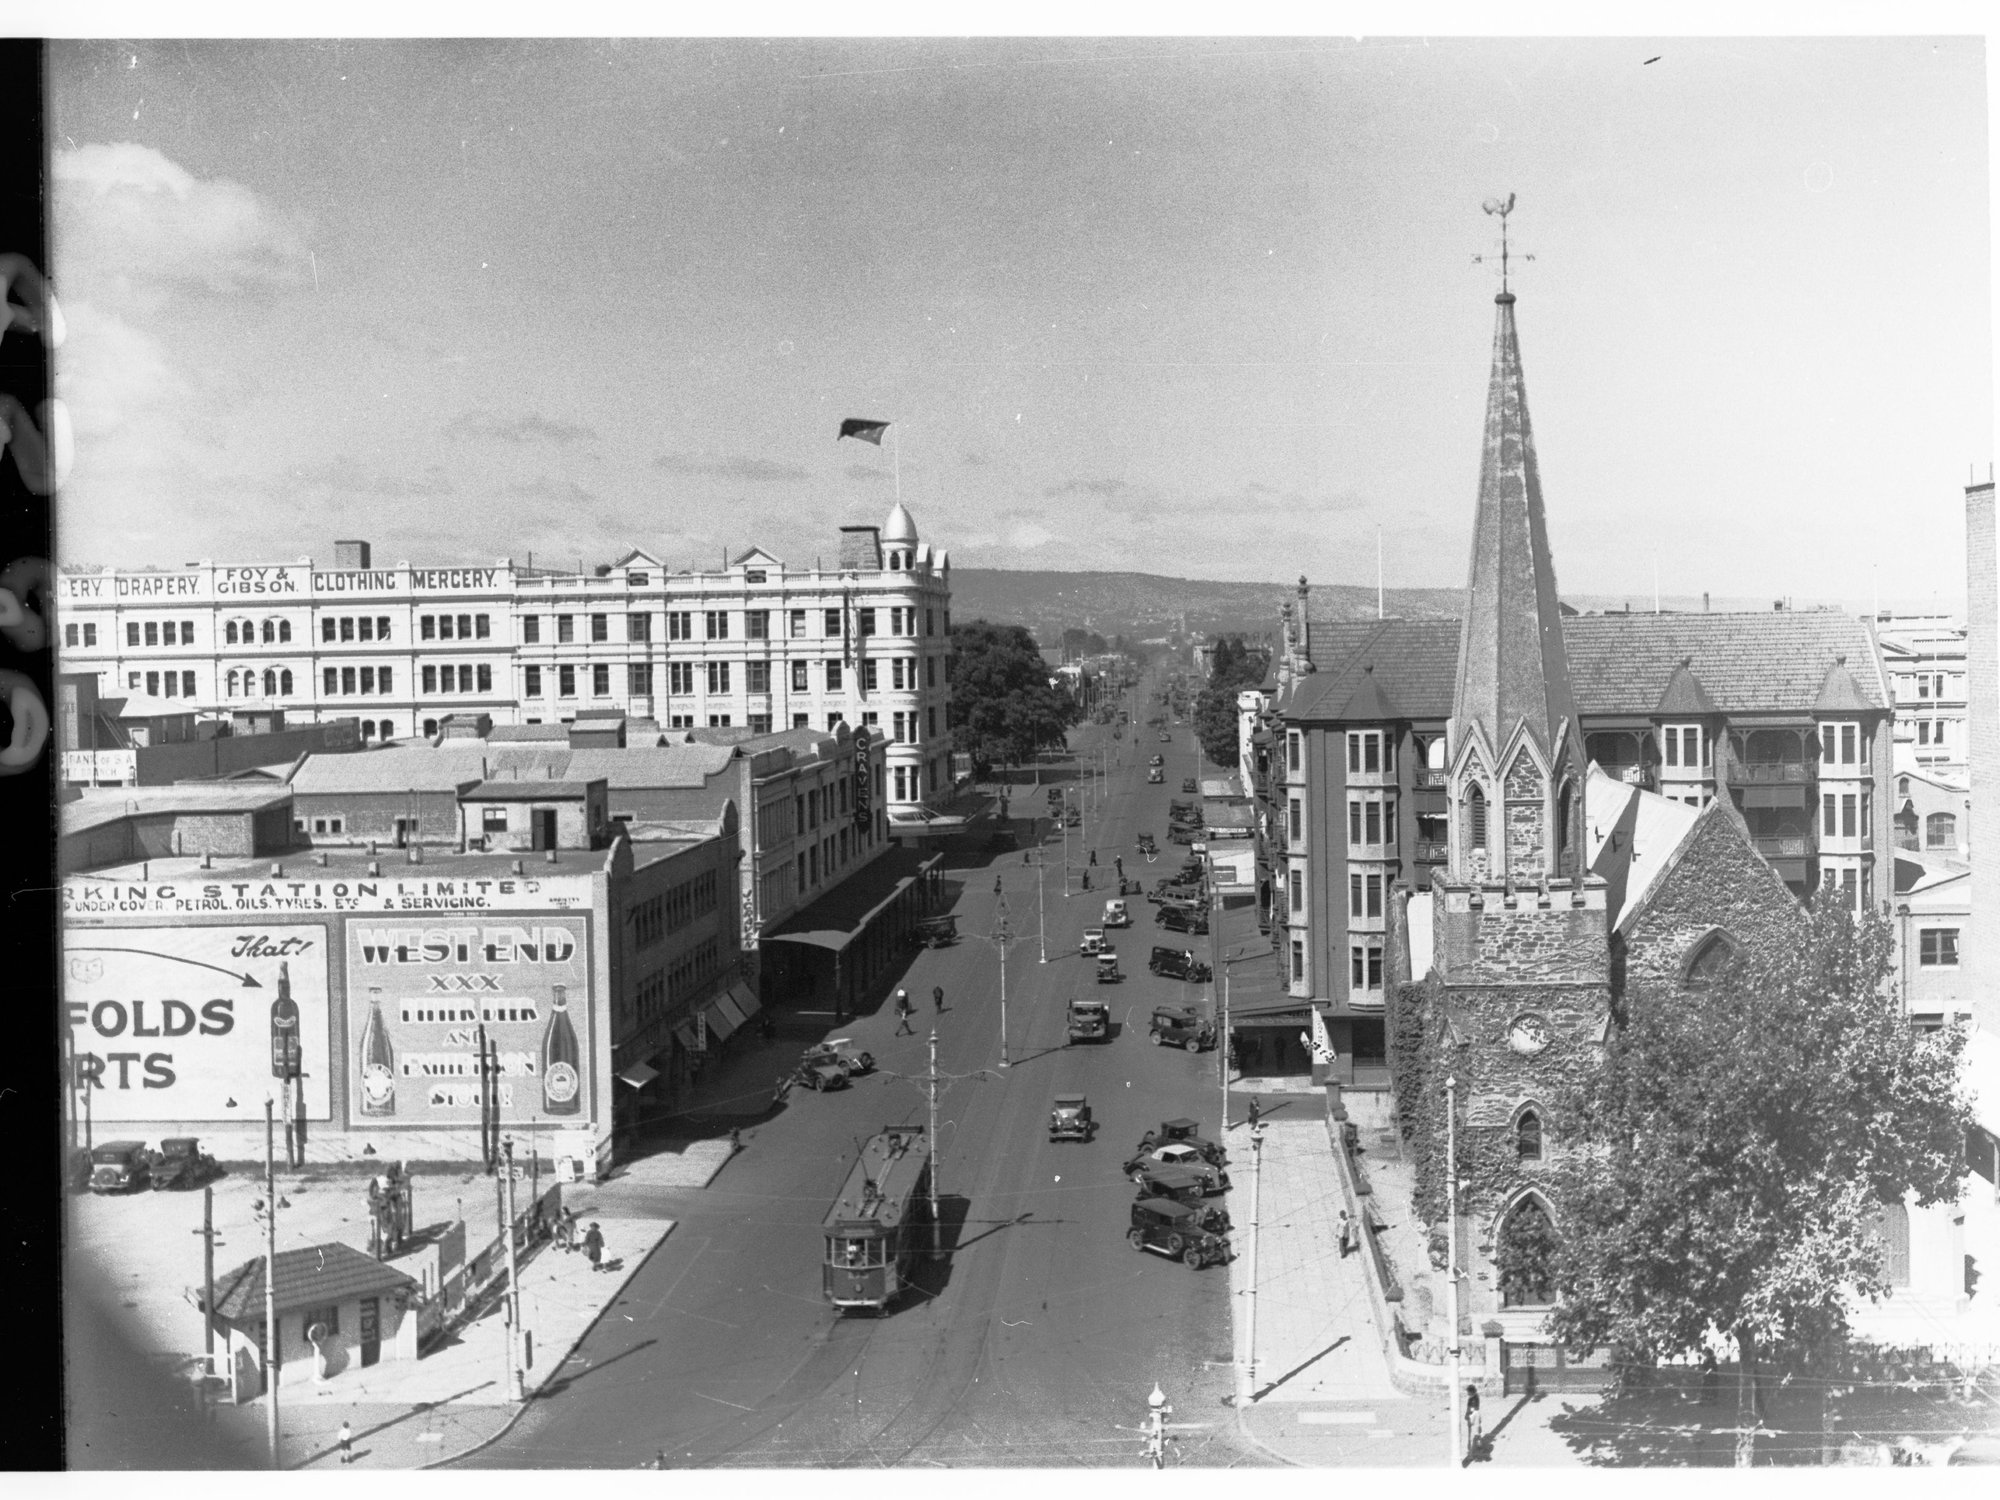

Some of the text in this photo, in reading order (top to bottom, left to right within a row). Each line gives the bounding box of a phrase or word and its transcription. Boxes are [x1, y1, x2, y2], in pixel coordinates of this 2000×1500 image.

[226, 566, 289, 581] FOY &
[413, 569, 497, 589] MERCERY.
[119, 576, 200, 596] DRAPERY.
[217, 581, 299, 594] GIBSON.
[855, 736, 869, 823] CRAVENS
[203, 882, 378, 898] STATION
[397, 880, 541, 897] LIMITED
[75, 900, 115, 912] UNDER
[383, 898, 395, 910] &
[230, 934, 314, 958] That!
[356, 925, 577, 965] WEST END
[425, 973, 504, 993] XXX
[64, 998, 235, 1038] FOLDS
[399, 996, 541, 1024] BITTER BEER
[442, 1027, 488, 1047] AND
[73, 1052, 177, 1090] RTS
